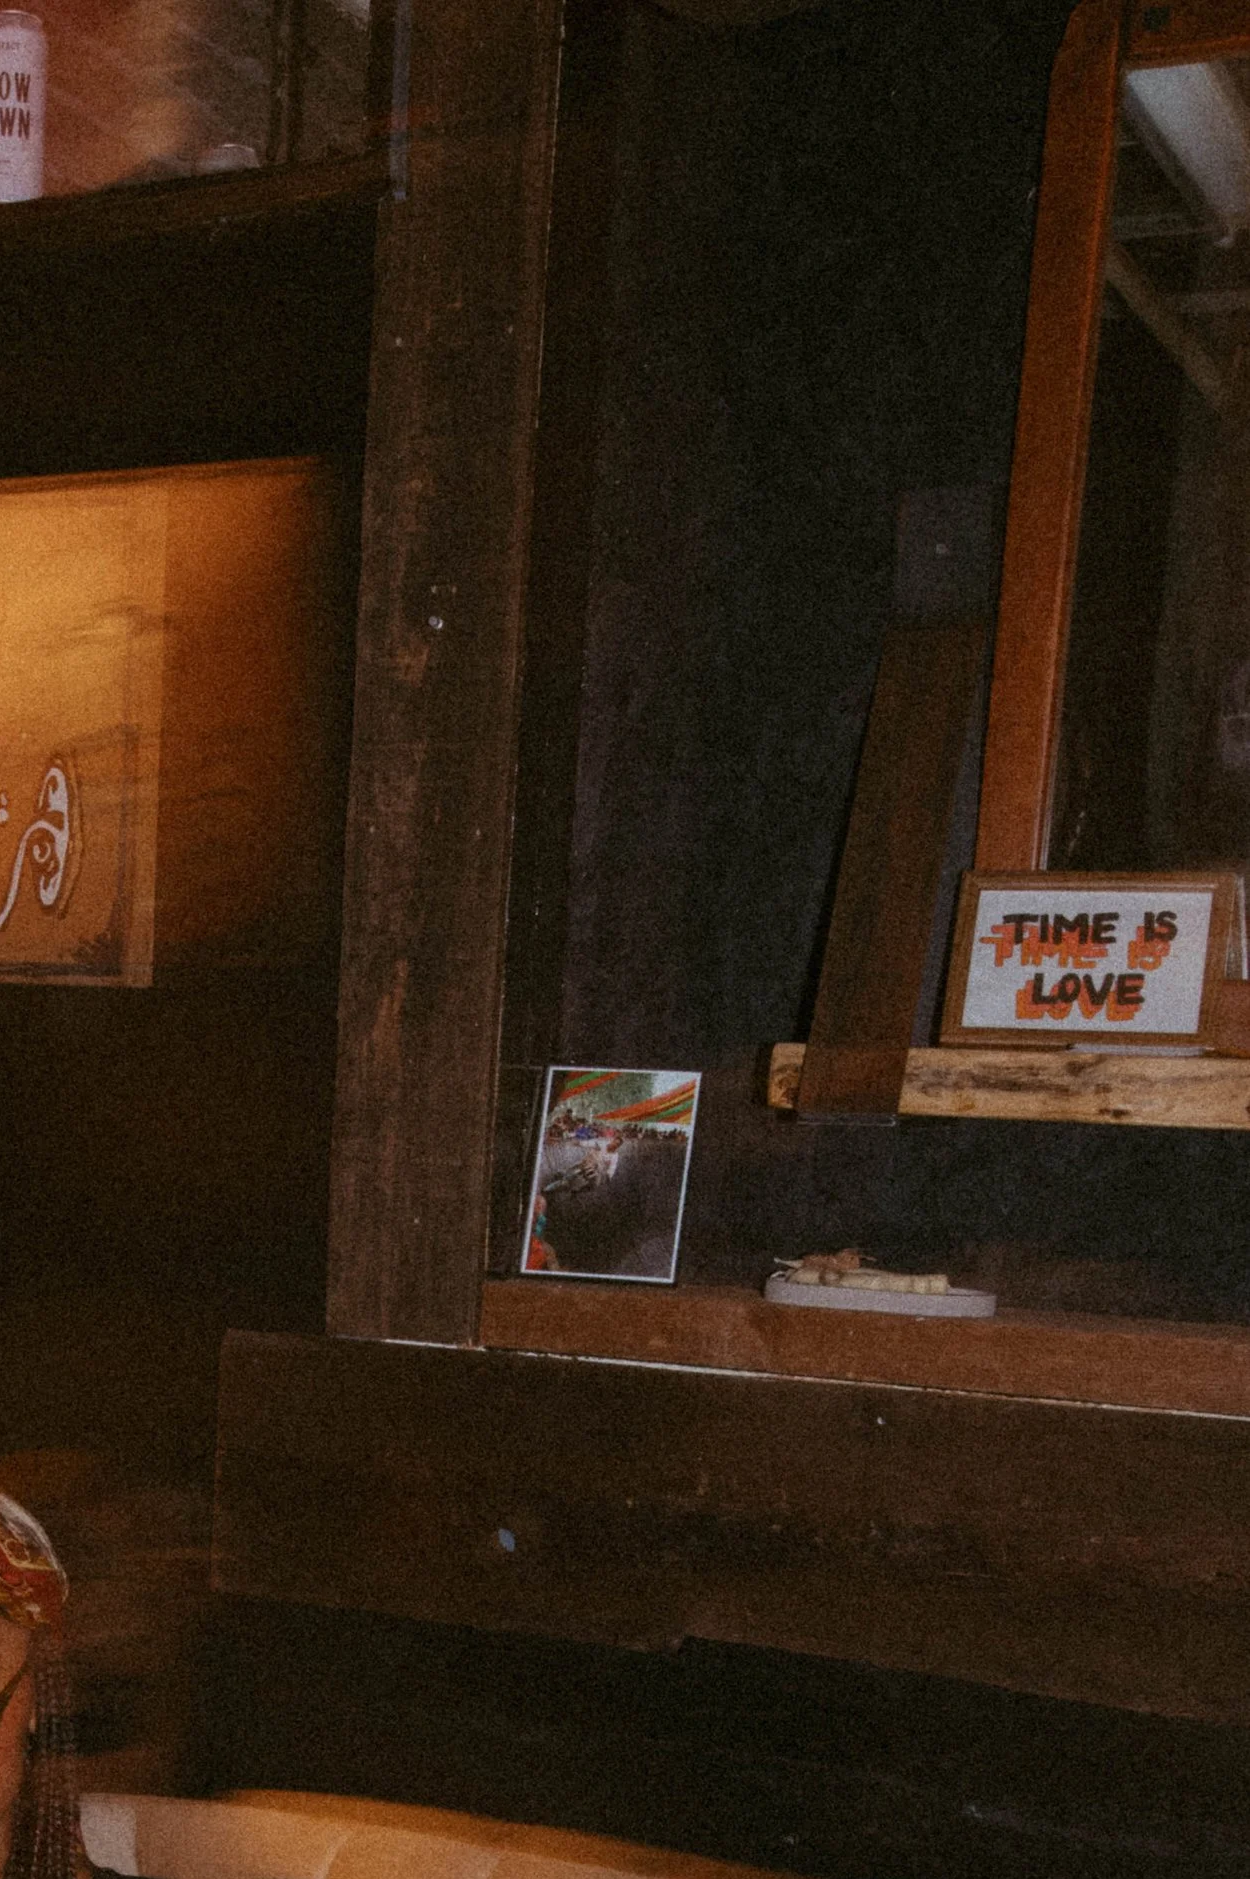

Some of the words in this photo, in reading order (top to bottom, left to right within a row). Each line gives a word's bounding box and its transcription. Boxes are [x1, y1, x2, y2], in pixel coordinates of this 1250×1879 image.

[991, 912, 1119, 958] TIME
[1137, 911, 1178, 954] IS
[1024, 972, 1145, 1014] LOVE
